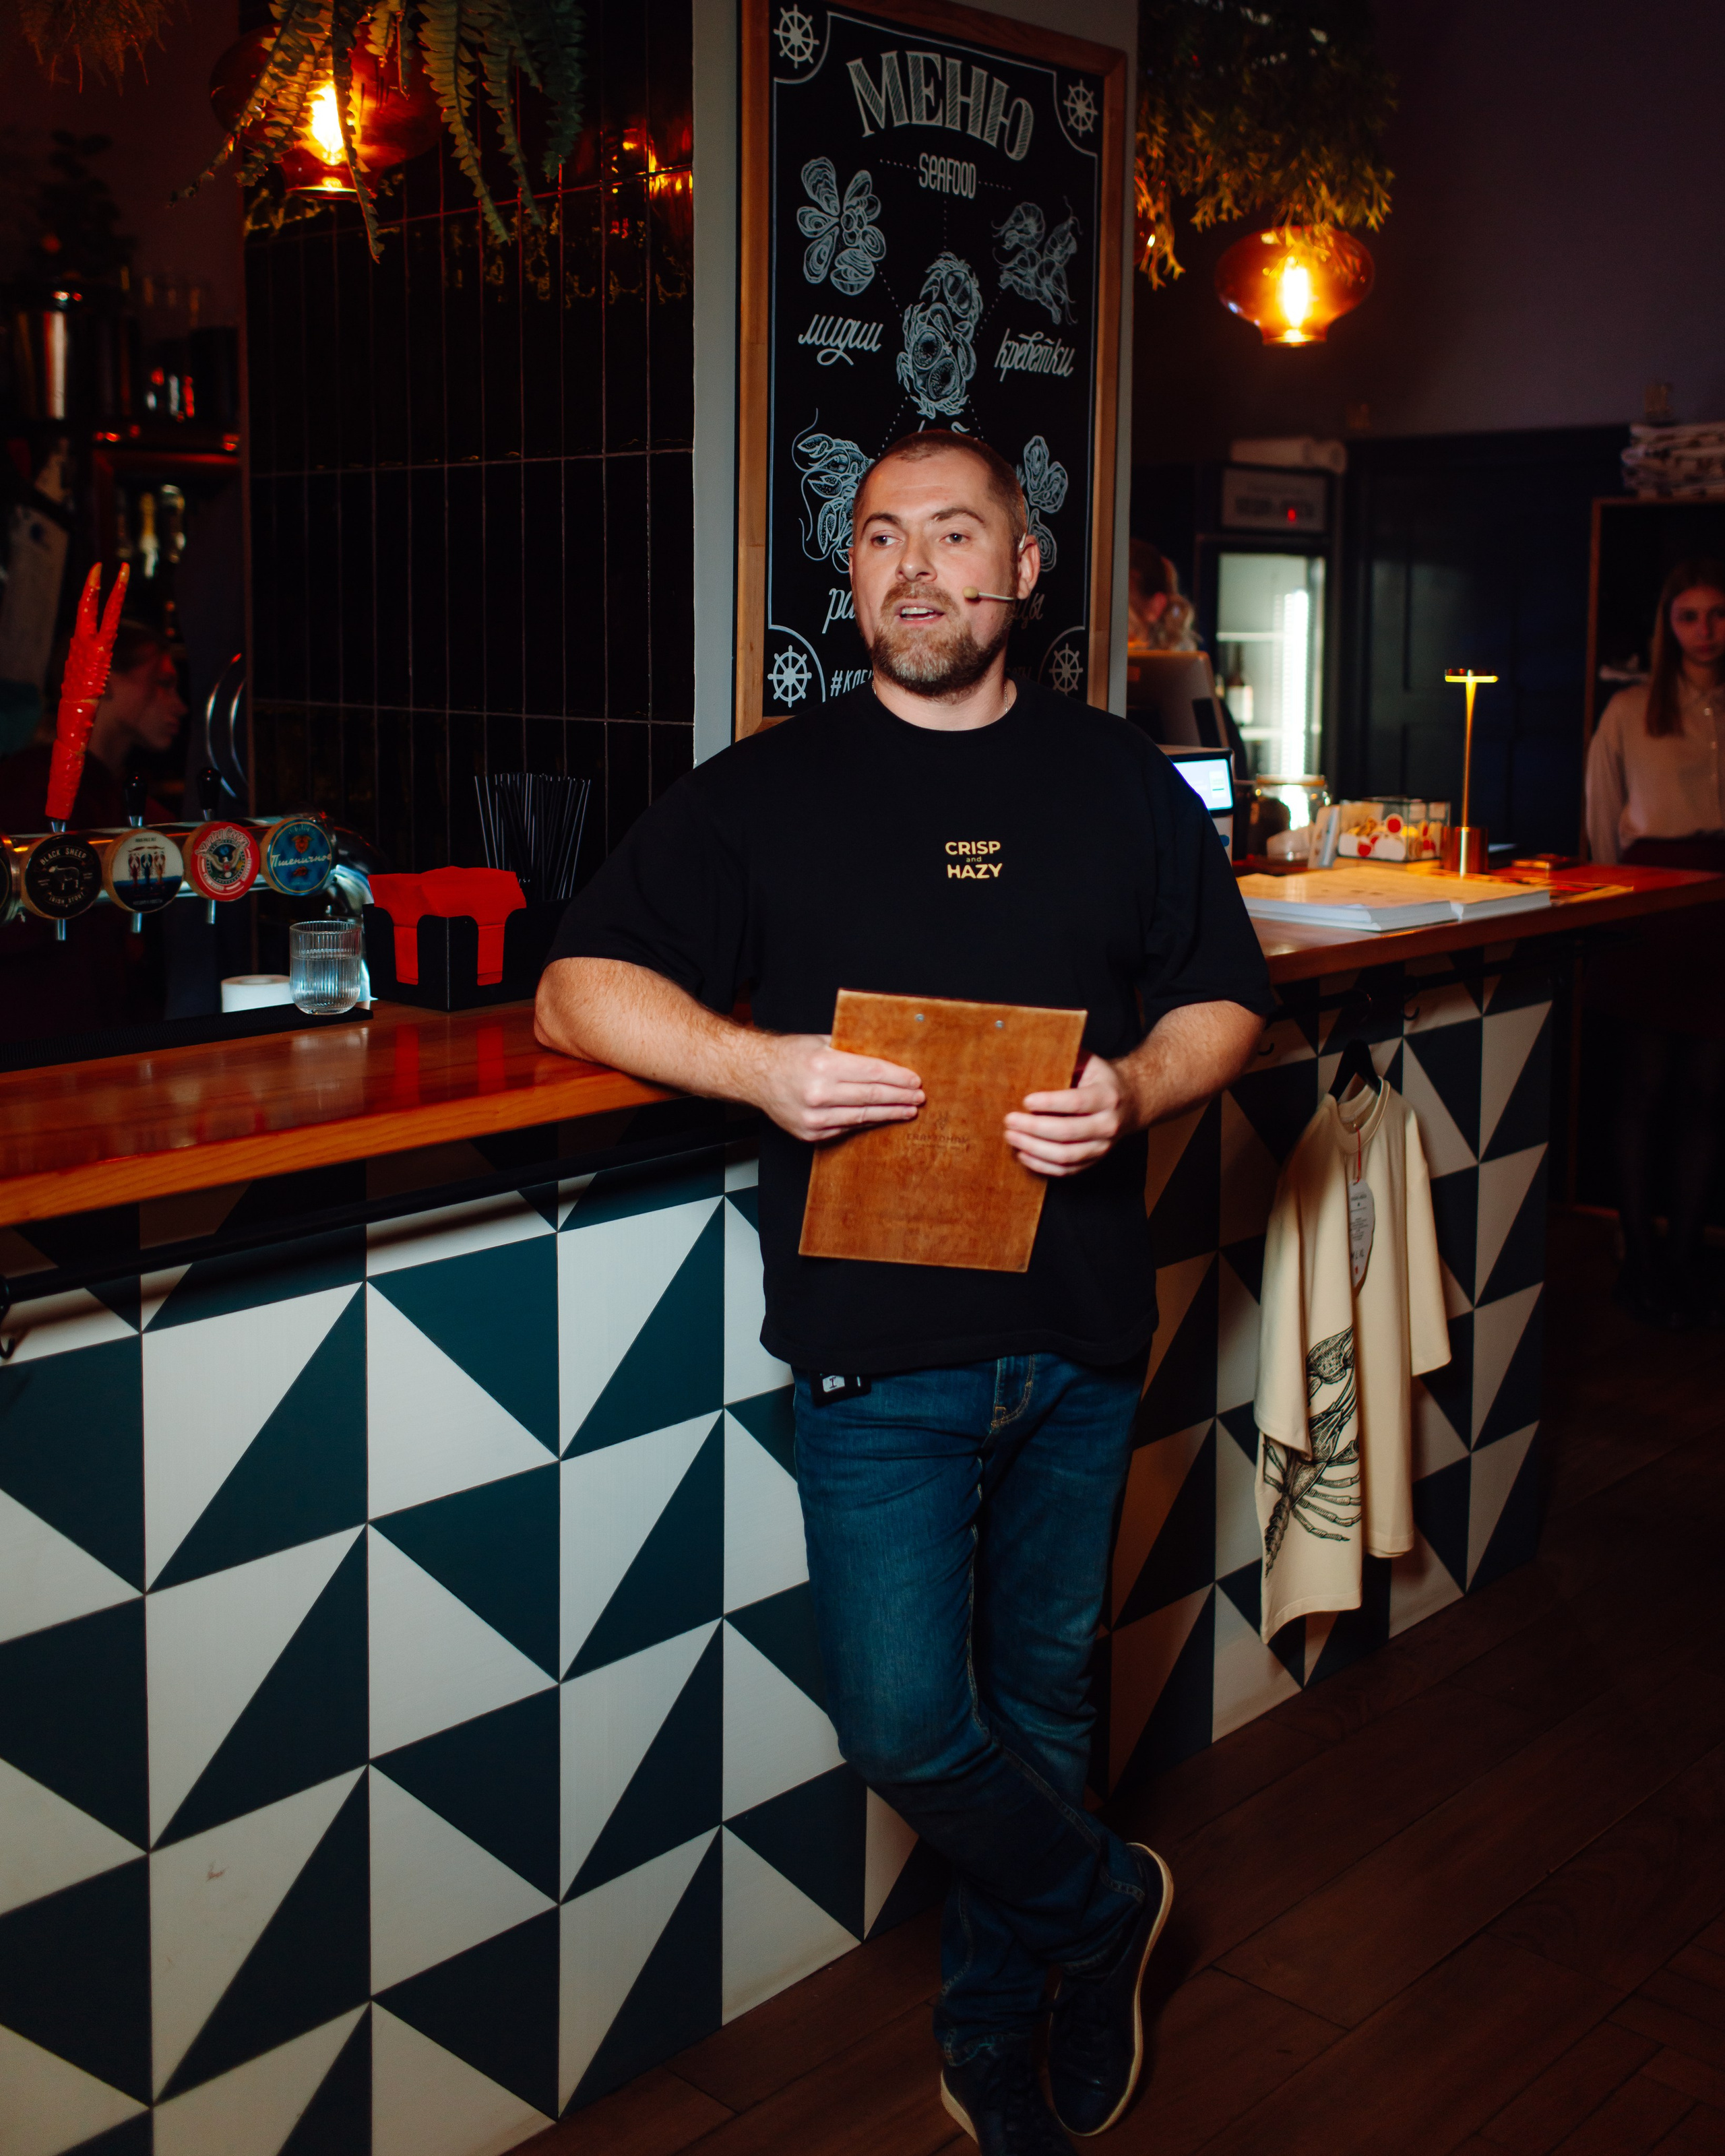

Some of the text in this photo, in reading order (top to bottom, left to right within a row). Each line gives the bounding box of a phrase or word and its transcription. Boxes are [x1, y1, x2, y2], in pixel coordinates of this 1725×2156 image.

[846, 51, 1034, 161] МЕНЮ
[798, 313, 883, 366] мидии
[994, 327, 1075, 382] креветки
[39, 847, 88, 866] BLACK SHEEP
[945, 841, 1001, 855] CRISP
[271, 853, 332, 868] Пшеничное
[947, 863, 1003, 879] HAZY
[49, 891, 85, 904] IRISH STOUT
